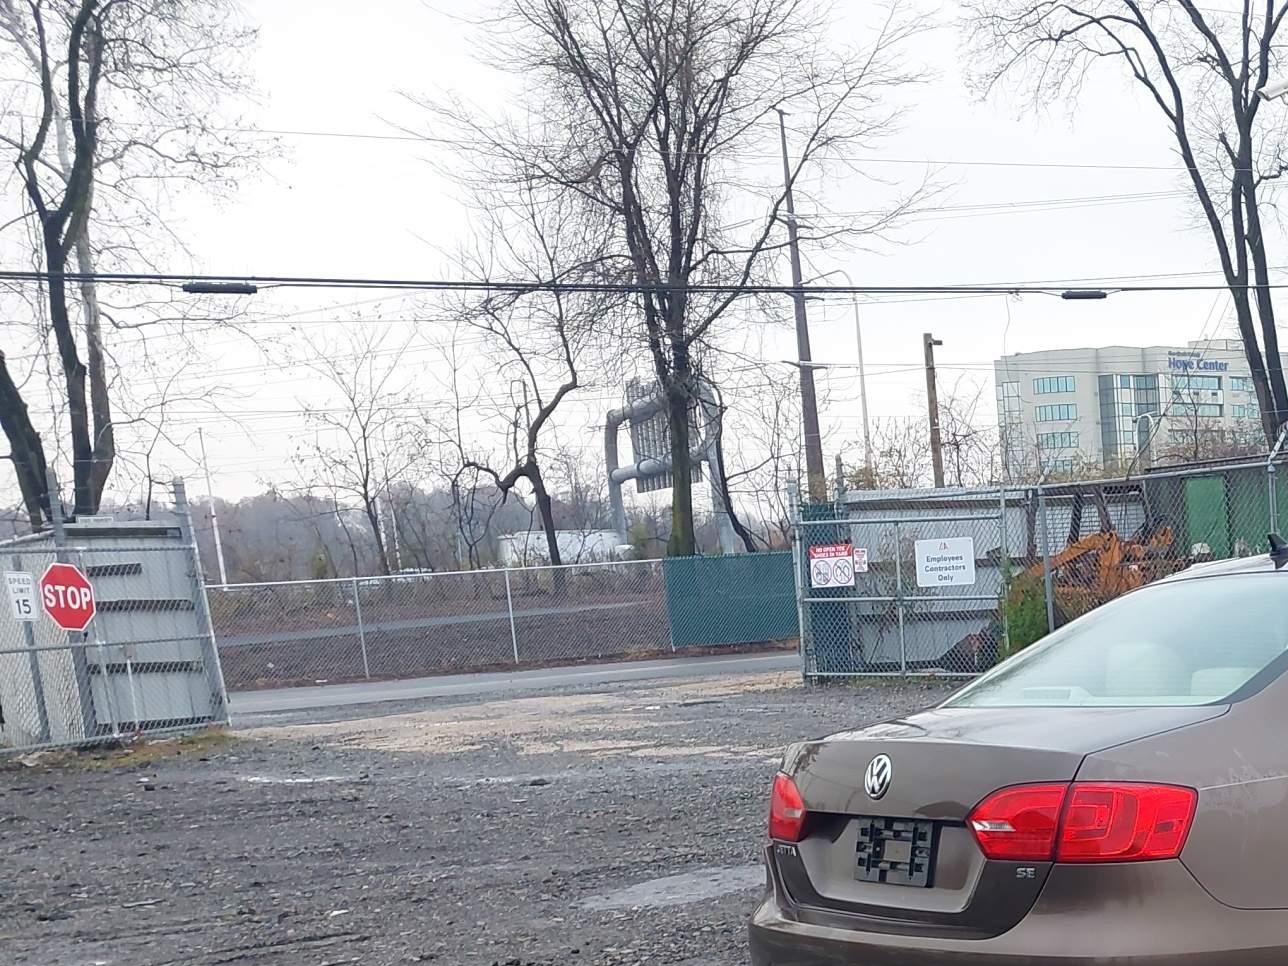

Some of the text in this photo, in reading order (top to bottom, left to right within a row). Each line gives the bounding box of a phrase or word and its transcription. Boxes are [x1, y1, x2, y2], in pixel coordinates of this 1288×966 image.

[1196, 359, 1229, 371] Center
[926, 554, 963, 563] Employees
[924, 564, 966, 573] Contractors
[8, 577, 31, 585] SPEED
[937, 574, 954, 582] Only
[44, 584, 91, 610] STOP
[15, 599, 32, 615] 15
[1015, 867, 1036, 879] SE
